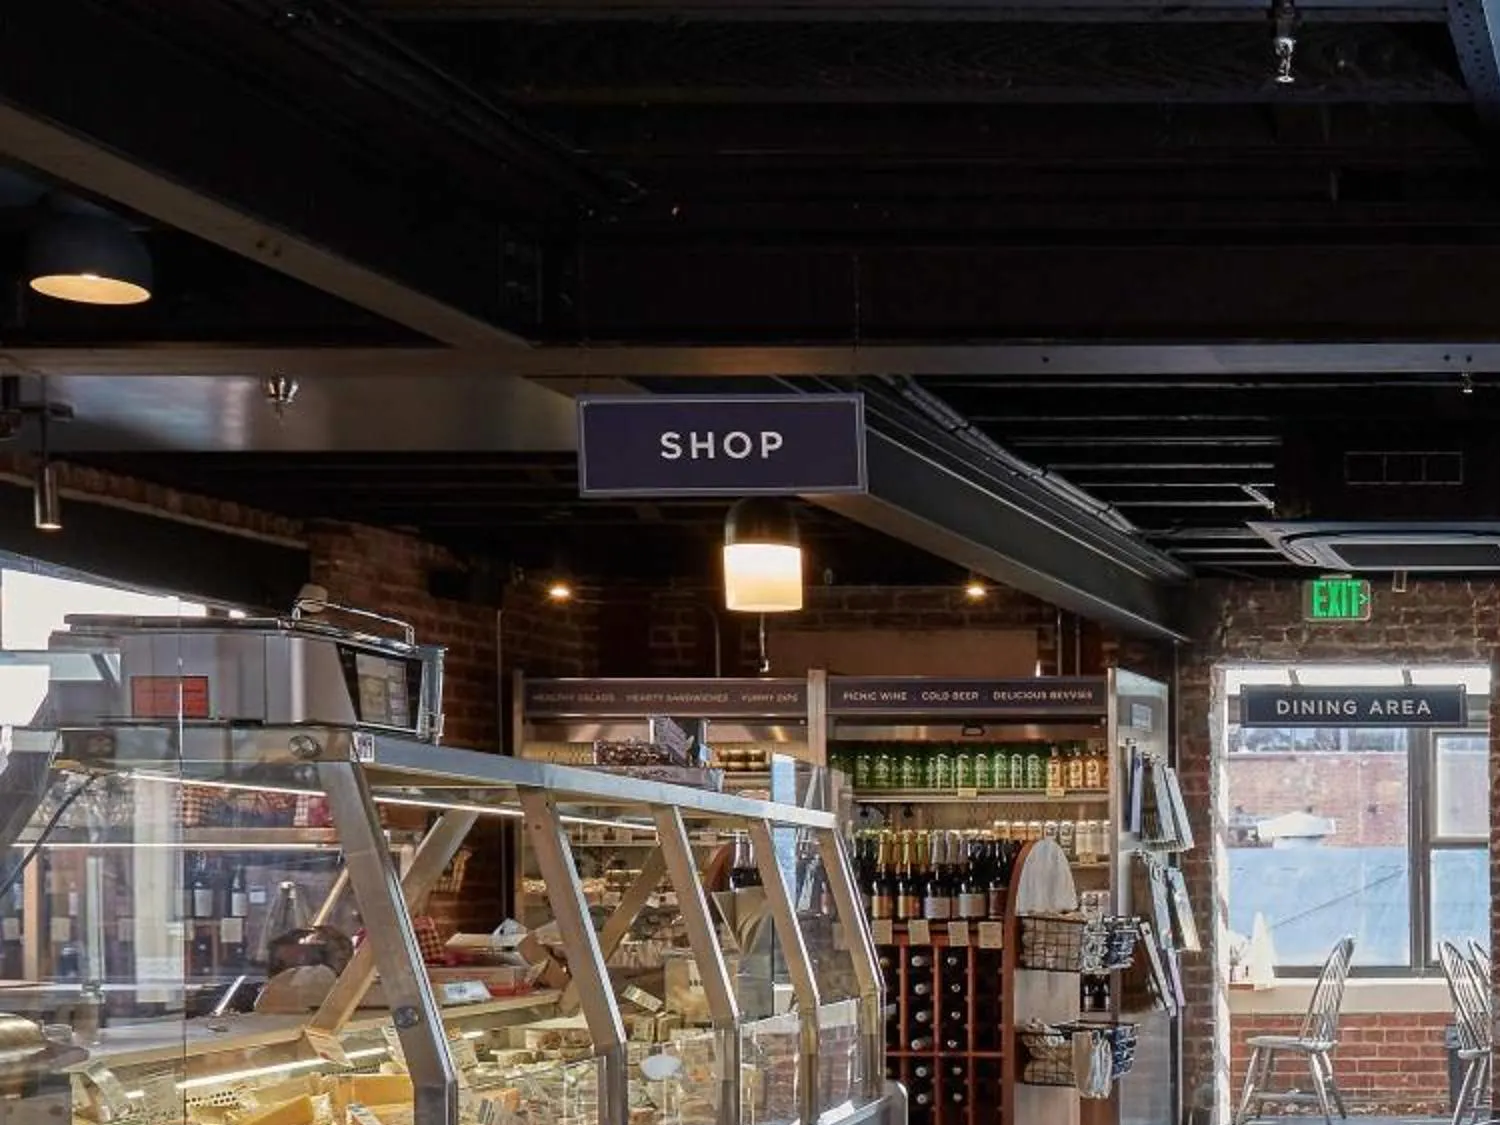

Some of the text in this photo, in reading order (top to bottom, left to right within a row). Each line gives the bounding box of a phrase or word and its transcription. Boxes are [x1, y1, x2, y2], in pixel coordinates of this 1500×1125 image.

[660, 431, 783, 459] SHOP
[1312, 580, 1361, 617] EXIT
[843, 691, 877, 701] PICNIC
[879, 691, 908, 701] WINE
[921, 691, 950, 701] COLD
[952, 691, 979, 701] BEER
[993, 691, 1047, 700] DELICIOUS
[1276, 699, 1431, 715] DINING AREA
